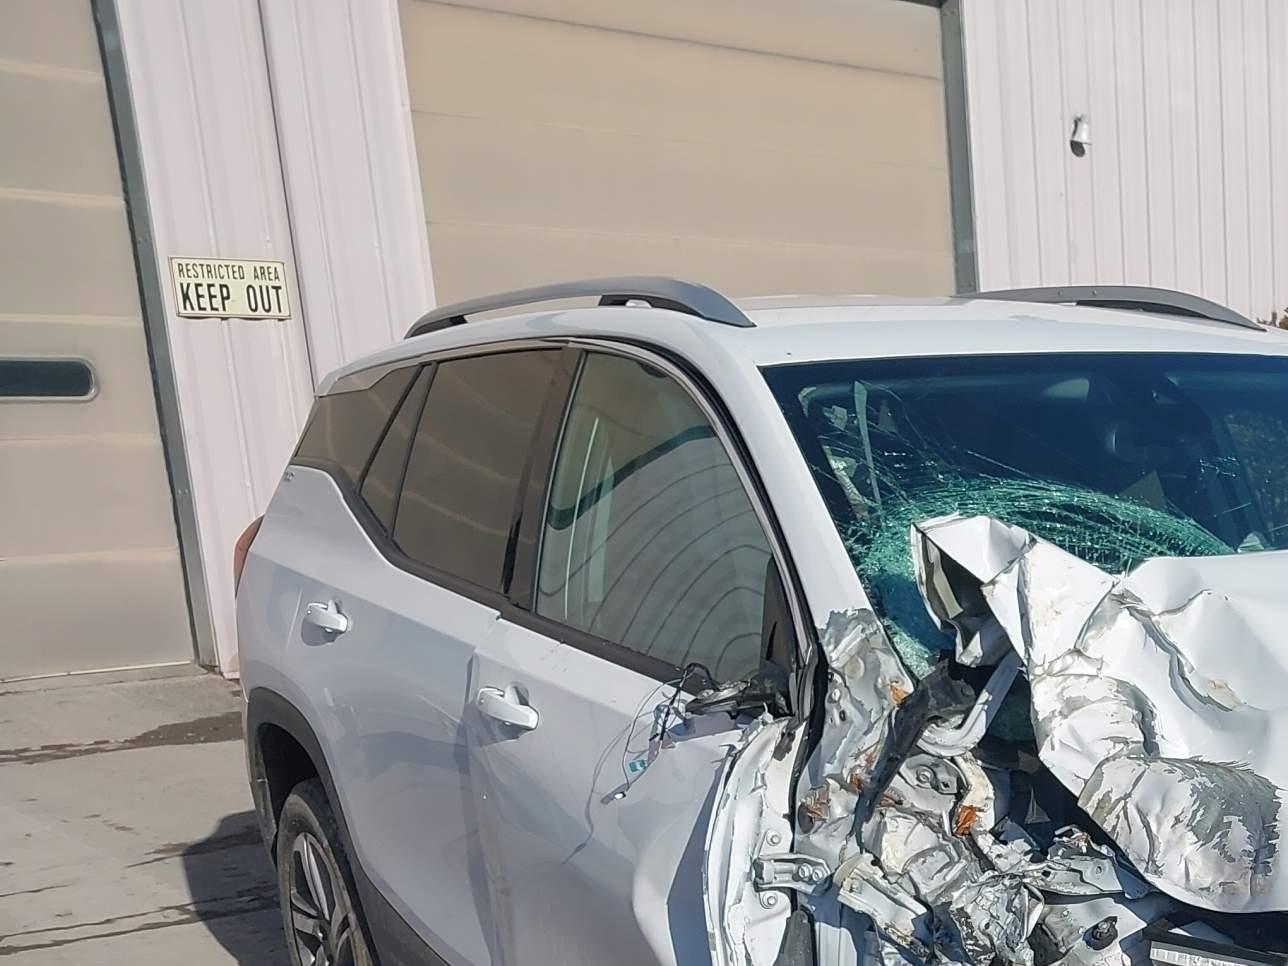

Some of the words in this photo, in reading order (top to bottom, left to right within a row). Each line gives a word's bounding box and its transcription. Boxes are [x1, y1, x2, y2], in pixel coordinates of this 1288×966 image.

[178, 263, 245, 280] RESTRICTED
[253, 266, 280, 282] AREA
[180, 282, 230, 312] KEEP
[246, 284, 282, 313] OUT
